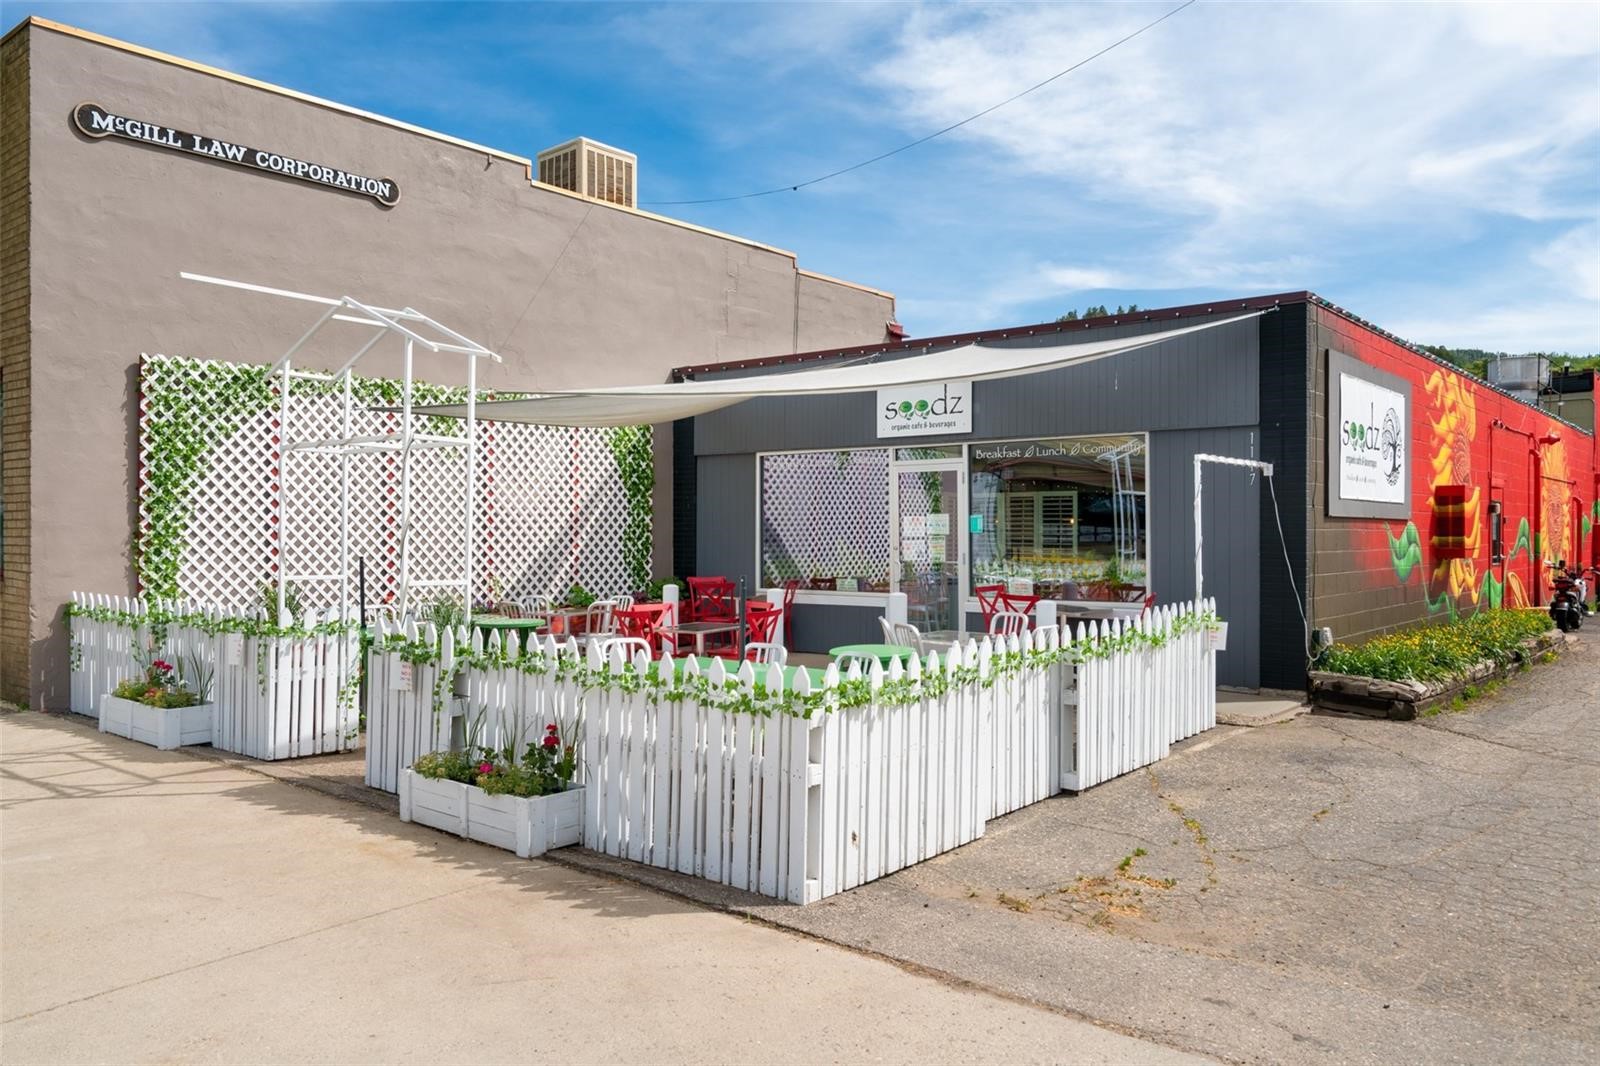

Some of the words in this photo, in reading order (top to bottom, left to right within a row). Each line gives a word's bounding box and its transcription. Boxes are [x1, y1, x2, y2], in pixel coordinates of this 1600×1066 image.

[192, 135, 247, 162] LAW
[255, 151, 391, 198] CORPORATION
[975, 446, 1022, 460] Breakfast
[1036, 443, 1067, 457] Lunch
[1082, 442, 1141, 457] Community
